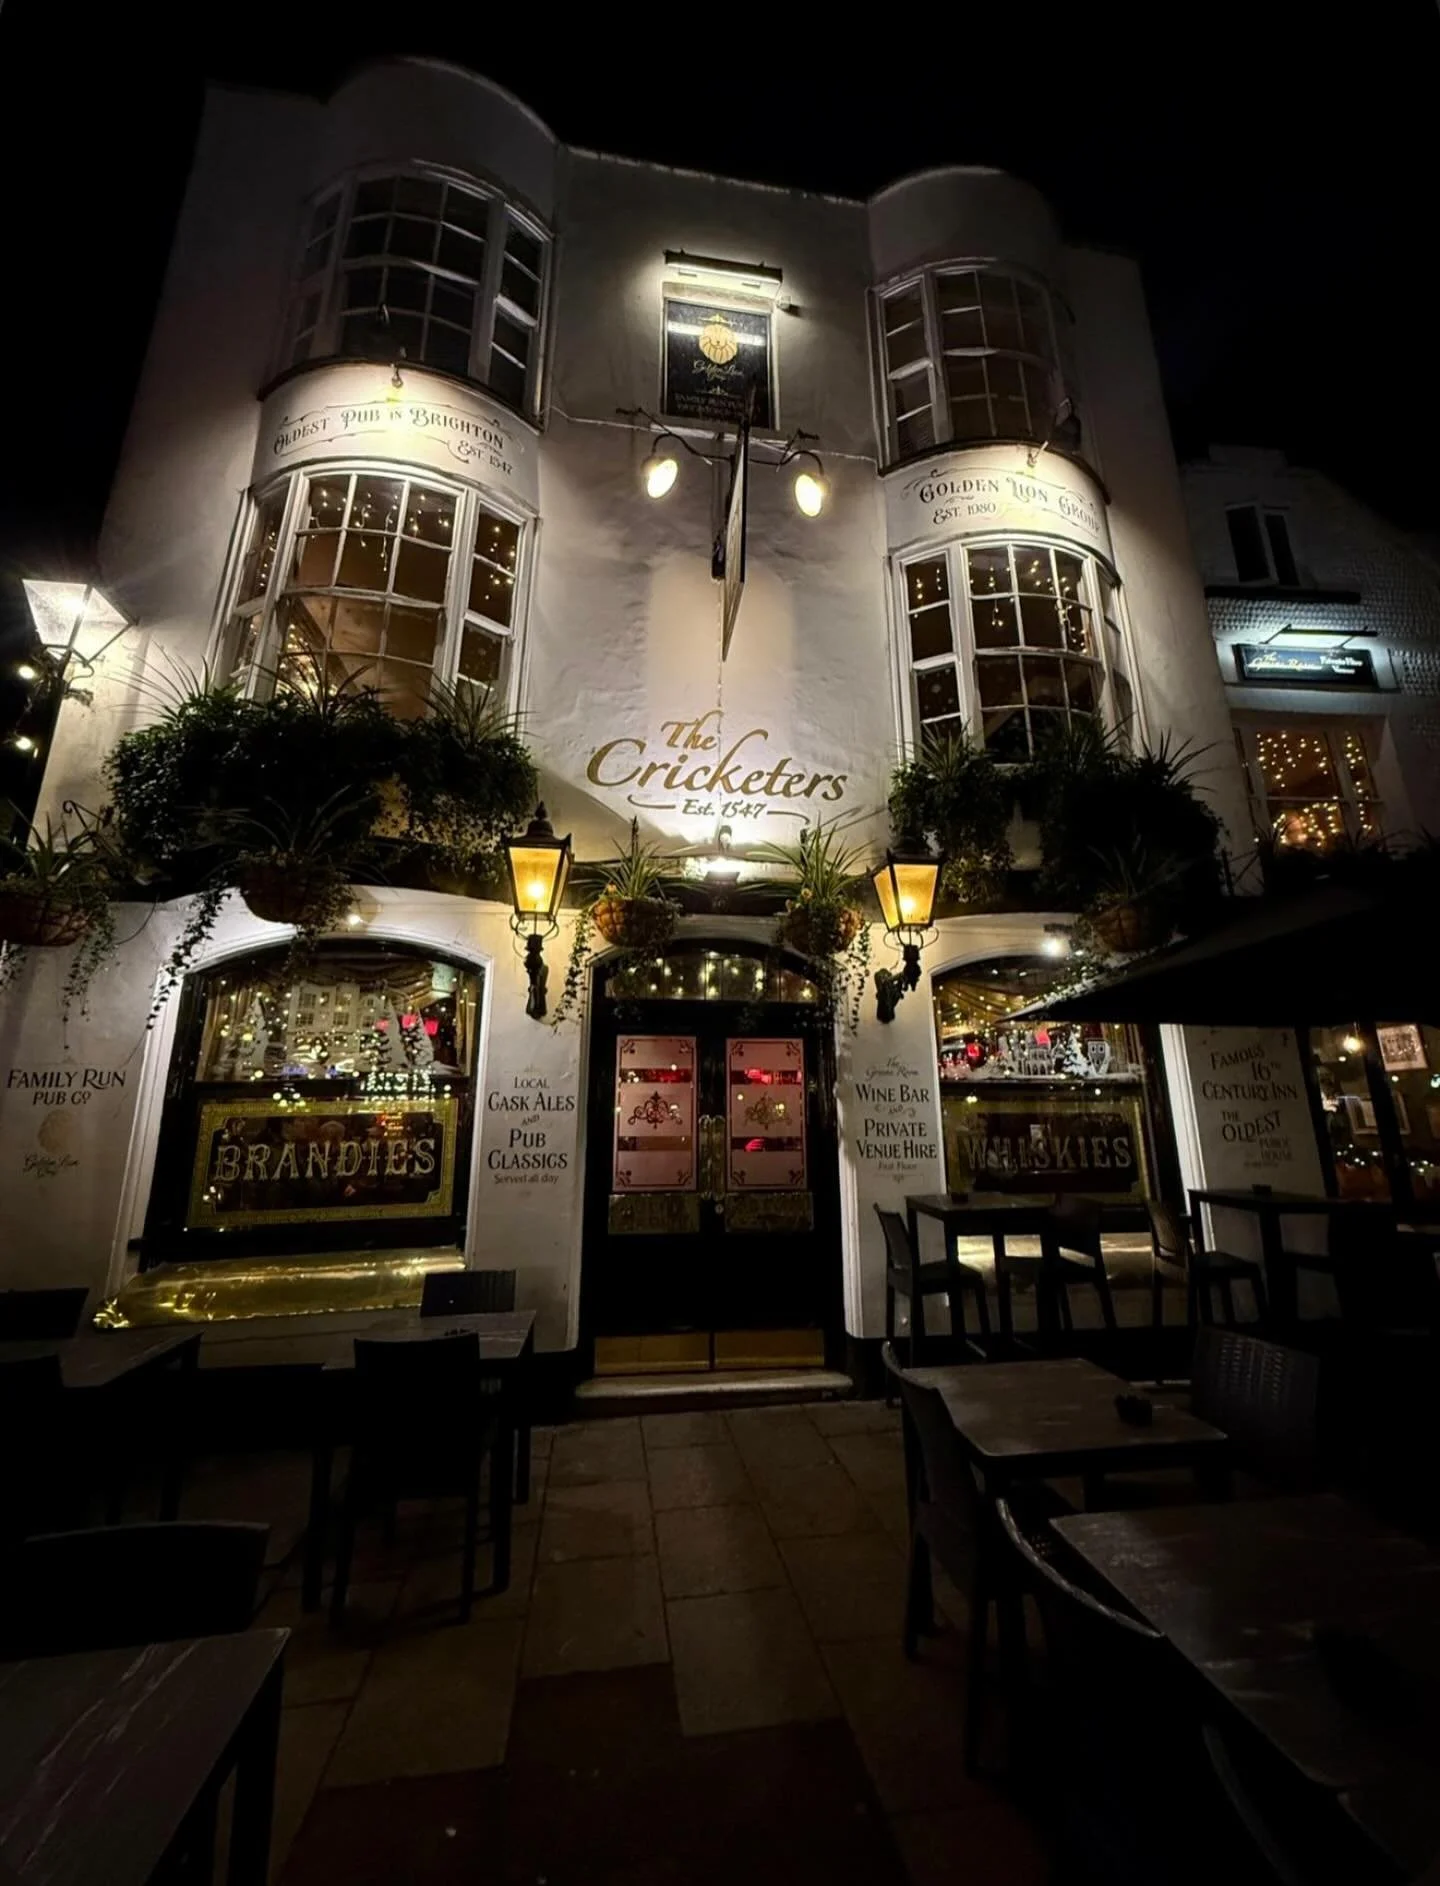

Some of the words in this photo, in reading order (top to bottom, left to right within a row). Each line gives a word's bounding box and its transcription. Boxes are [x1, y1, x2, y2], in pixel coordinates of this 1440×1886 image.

[274, 416, 331, 455] OLDEST
[341, 408, 381, 430] PUB
[409, 408, 504, 449] BRIGHTON
[918, 479, 1000, 503] GOLDEN
[1006, 476, 1049, 503] LION
[660, 710, 724, 751] The
[586, 729, 847, 801] Cricketers
[681, 798, 716, 816] Est.
[720, 801, 767, 818] 1547
[1210, 1045, 1265, 1071] FAMOUS
[6, 1069, 78, 1089] FAMILY
[82, 1068, 126, 1090] RUN
[513, 1076, 551, 1089] LOCAL
[32, 1091, 67, 1106] PUB
[488, 1091, 530, 1112] CASK
[533, 1091, 575, 1112] ALES
[855, 1083, 897, 1103] WINE
[900, 1083, 930, 1103] BAR
[1202, 1080, 1269, 1102] CENTURY
[1271, 1081, 1299, 1100] INN
[864, 1118, 928, 1138] PRIVATE
[1222, 1109, 1281, 1143] OLDEST
[509, 1127, 546, 1149] PUB
[213, 1138, 436, 1182] BRANDIES
[487, 1149, 568, 1170] CLASSICS
[856, 1139, 901, 1160] VENUE
[903, 1139, 937, 1160] HIRE
[963, 1135, 1134, 1173] WHISKIES
